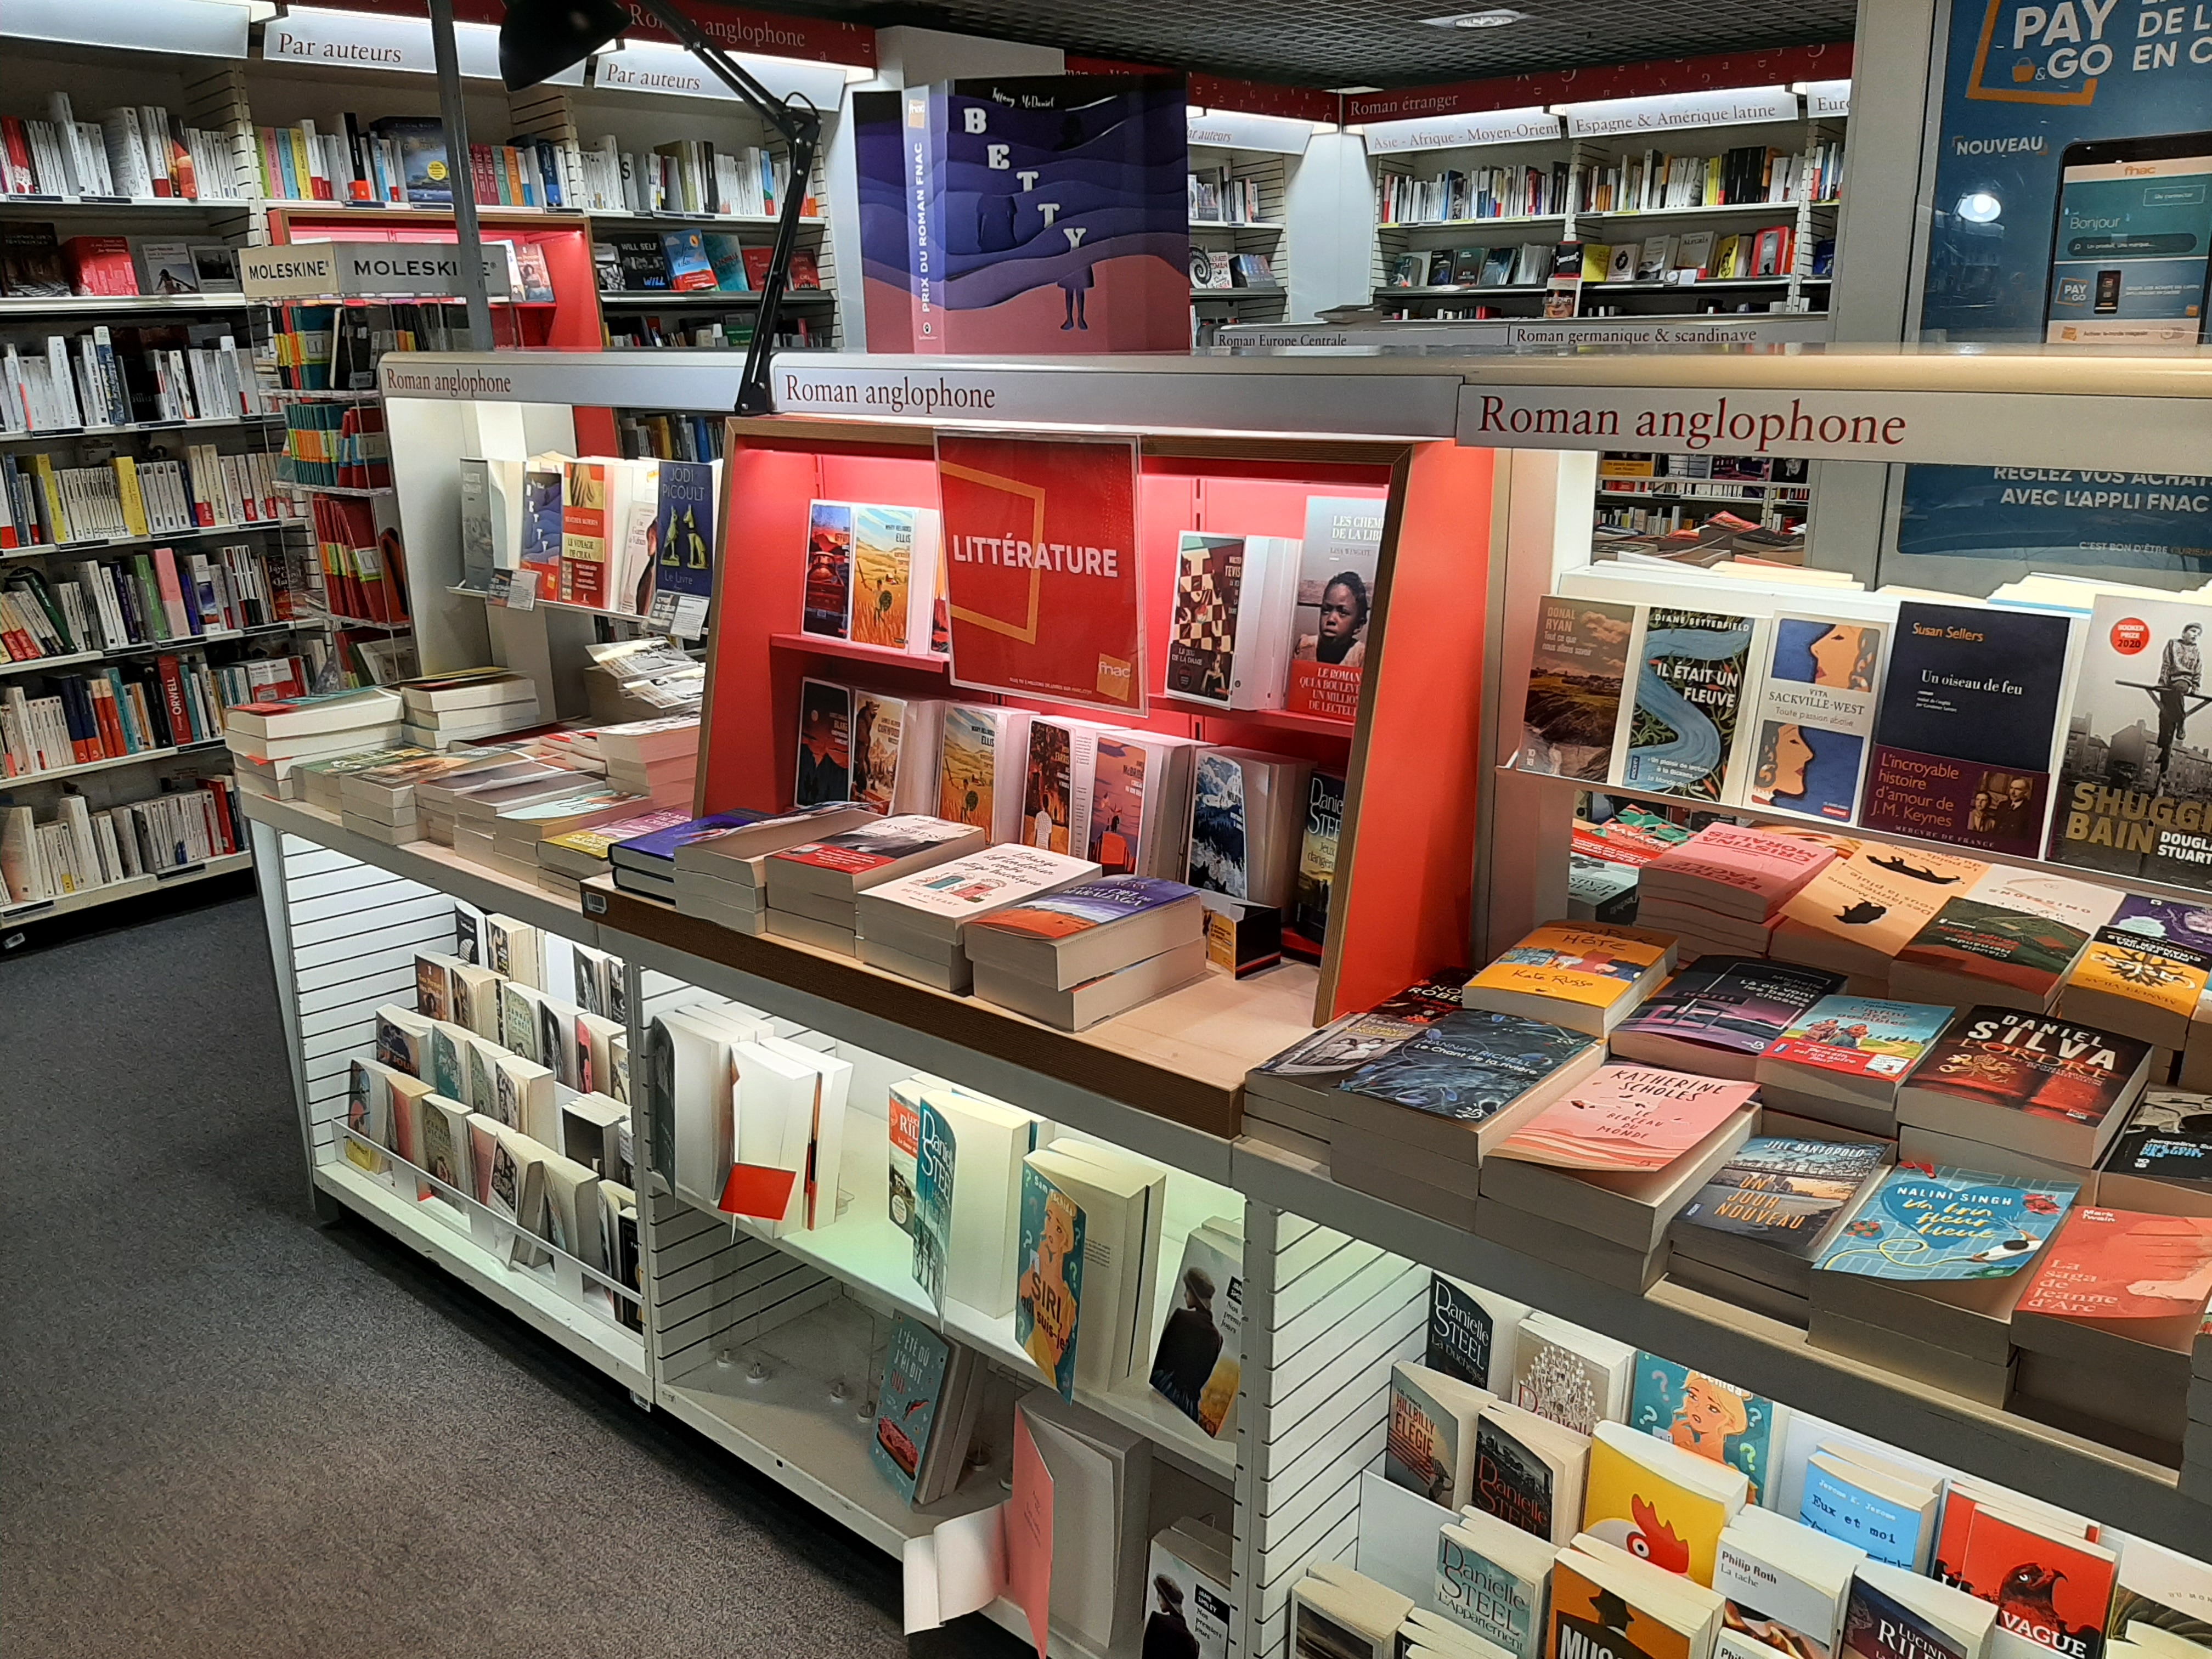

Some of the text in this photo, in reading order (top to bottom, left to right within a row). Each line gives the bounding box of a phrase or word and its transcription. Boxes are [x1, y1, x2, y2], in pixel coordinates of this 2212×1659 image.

[705, 17, 805, 47] anglophone
[2013, 1, 2117, 49] PAY
[2137, 7, 2185, 38] DE
[278, 33, 402, 64] Par auteurs
[2133, 41, 2177, 71] EN
[2047, 43, 2113, 79] GO
[606, 64, 701, 91] Par auteurs
[1351, 93, 1458, 116] Roman étranger
[1576, 104, 1776, 134] Espagne & Amérique latine
[1374, 122, 1560, 149] Asie Afrique Moyen-Orient
[1957, 136, 2043, 155] NOUVEAU
[2125, 166, 2157, 176] fnac
[915, 142, 930, 312] PRIX DU ROMAN FNAC
[2070, 217, 2120, 231] Bonjour
[622, 242, 657, 251] WILL SELF
[249, 261, 326, 280] MOLESKINE
[643, 276, 665, 286] WILL
[2064, 285, 2087, 295] PAY
[1218, 334, 1347, 346] Roman Europe Centrale
[1517, 328, 1757, 345] Roman germanique & scandinave
[386, 368, 511, 397] Roman anglophone
[786, 374, 996, 414] Roman anglophone
[1477, 395, 1906, 453] Roman anglophone
[670, 467, 694, 483] JODI
[2080, 471, 2125, 484] VOS
[663, 484, 705, 501] PICOULT
[2000, 488, 2210, 512] AVEC L'APPLI FNAC
[1333, 515, 1352, 527] LES
[1332, 528, 1362, 540] DE LA
[953, 533, 1119, 579] LITTÉRATURE
[2109, 543, 2132, 552] BON
[664, 571, 694, 585] Le Livre
[1547, 607, 1576, 619] DONAL
[1655, 613, 1750, 632] DIANE SETTERFIELD
[1545, 618, 1572, 633] RYAN
[1912, 622, 1984, 642] Susan Sellers
[2118, 638, 2142, 649] 2020
[1098, 660, 1132, 678] fnac
[1318, 667, 1361, 682] LE ROMAN
[1657, 662, 1739, 688] IL ÉTAIT UN
[1299, 676, 1314, 689] QUI
[1810, 688, 1828, 698] VITA
[1921, 669, 2023, 696] Un oiseau de feu
[171, 676, 182, 715] ORWELL
[1308, 699, 1321, 711] DE
[1683, 686, 1736, 709] FLEUVE
[1769, 691, 1865, 715] SACKVILLE-WEST
[1881, 753, 1960, 780] L'incroyable
[1878, 770, 1927, 791] histoire
[1876, 786, 1955, 812] d'amour de
[1871, 801, 1900, 818] J.M.
[1904, 808, 1953, 827] Keynes
[1941, 832, 1995, 848] DE FRANCE
[2066, 810, 2157, 854] BAIN
[1702, 836, 1811, 864] CRISTINA
[1709, 831, 1819, 858] MORALES
[1850, 871, 1936, 911] sous pluie
[1859, 883, 1932, 916] Des larmes
[1511, 969, 1594, 988] Kate Russo
[1756, 992, 1807, 1008] choses
[1768, 989, 1811, 1003] belles
[1782, 988, 1816, 998] vont
[2002, 1015, 2104, 1048] DANIEL
[1967, 1021, 2117, 1070] SILVA
[1431, 1046, 1467, 1059] Chant
[1467, 1053, 1484, 1063] de
[1486, 1058, 1498, 1066] la
[1500, 1062, 1538, 1075] rivière
[1480, 1051, 1532, 1068] RICHELL
[1958, 1037, 2112, 1082] L'ORDRE
[1610, 1070, 1728, 1095] KATHERINE
[1618, 1081, 1702, 1102] SCHOLES
[1606, 1112, 1665, 1128] BERCEAU
[1635, 1110, 1652, 1118] LE
[1596, 1125, 1649, 1139] MONDE
[1622, 1122, 1639, 1131] DU
[1764, 1141, 1866, 1158] JILL SANTOPOLO
[1035, 1175, 1048, 1194] Sam
[1740, 1177, 1768, 1191] UN
[1727, 1188, 1781, 1209] JOUR
[1897, 1186, 2013, 1206] NALINI SINGH
[1714, 1202, 1806, 1230] NOUVEAU
[2082, 1214, 2117, 1223] Twain
[2083, 1208, 2115, 1217] Mark
[2043, 1268, 2098, 1284] saga
[2050, 1259, 2081, 1272] La
[2039, 1278, 2069, 1290] de
[2028, 1298, 2097, 1312] d'Arc
[2033, 1287, 2119, 1305] Jeanne
[1435, 1281, 1489, 1347] Danielle
[898, 1328, 930, 1367] L'ÉTÉ OÙ
[1434, 1305, 1486, 1372] STEEL
[894, 1349, 923, 1385] J'AI DIT
[1397, 1393, 1435, 1435] HILLBILLY
[1479, 1455, 1548, 1527] Danielle
[1812, 1494, 1896, 1545] Eux et moi
[1442, 1538, 1526, 1610] Danielle
[1720, 1564, 1759, 1588] La tache
[1722, 1551, 1777, 1584] Philip Roth
[1442, 1566, 1520, 1637] STEEL
[1437, 1592, 1523, 1652] L'Appartement
[2001, 1611, 2087, 1659] VAGUE
